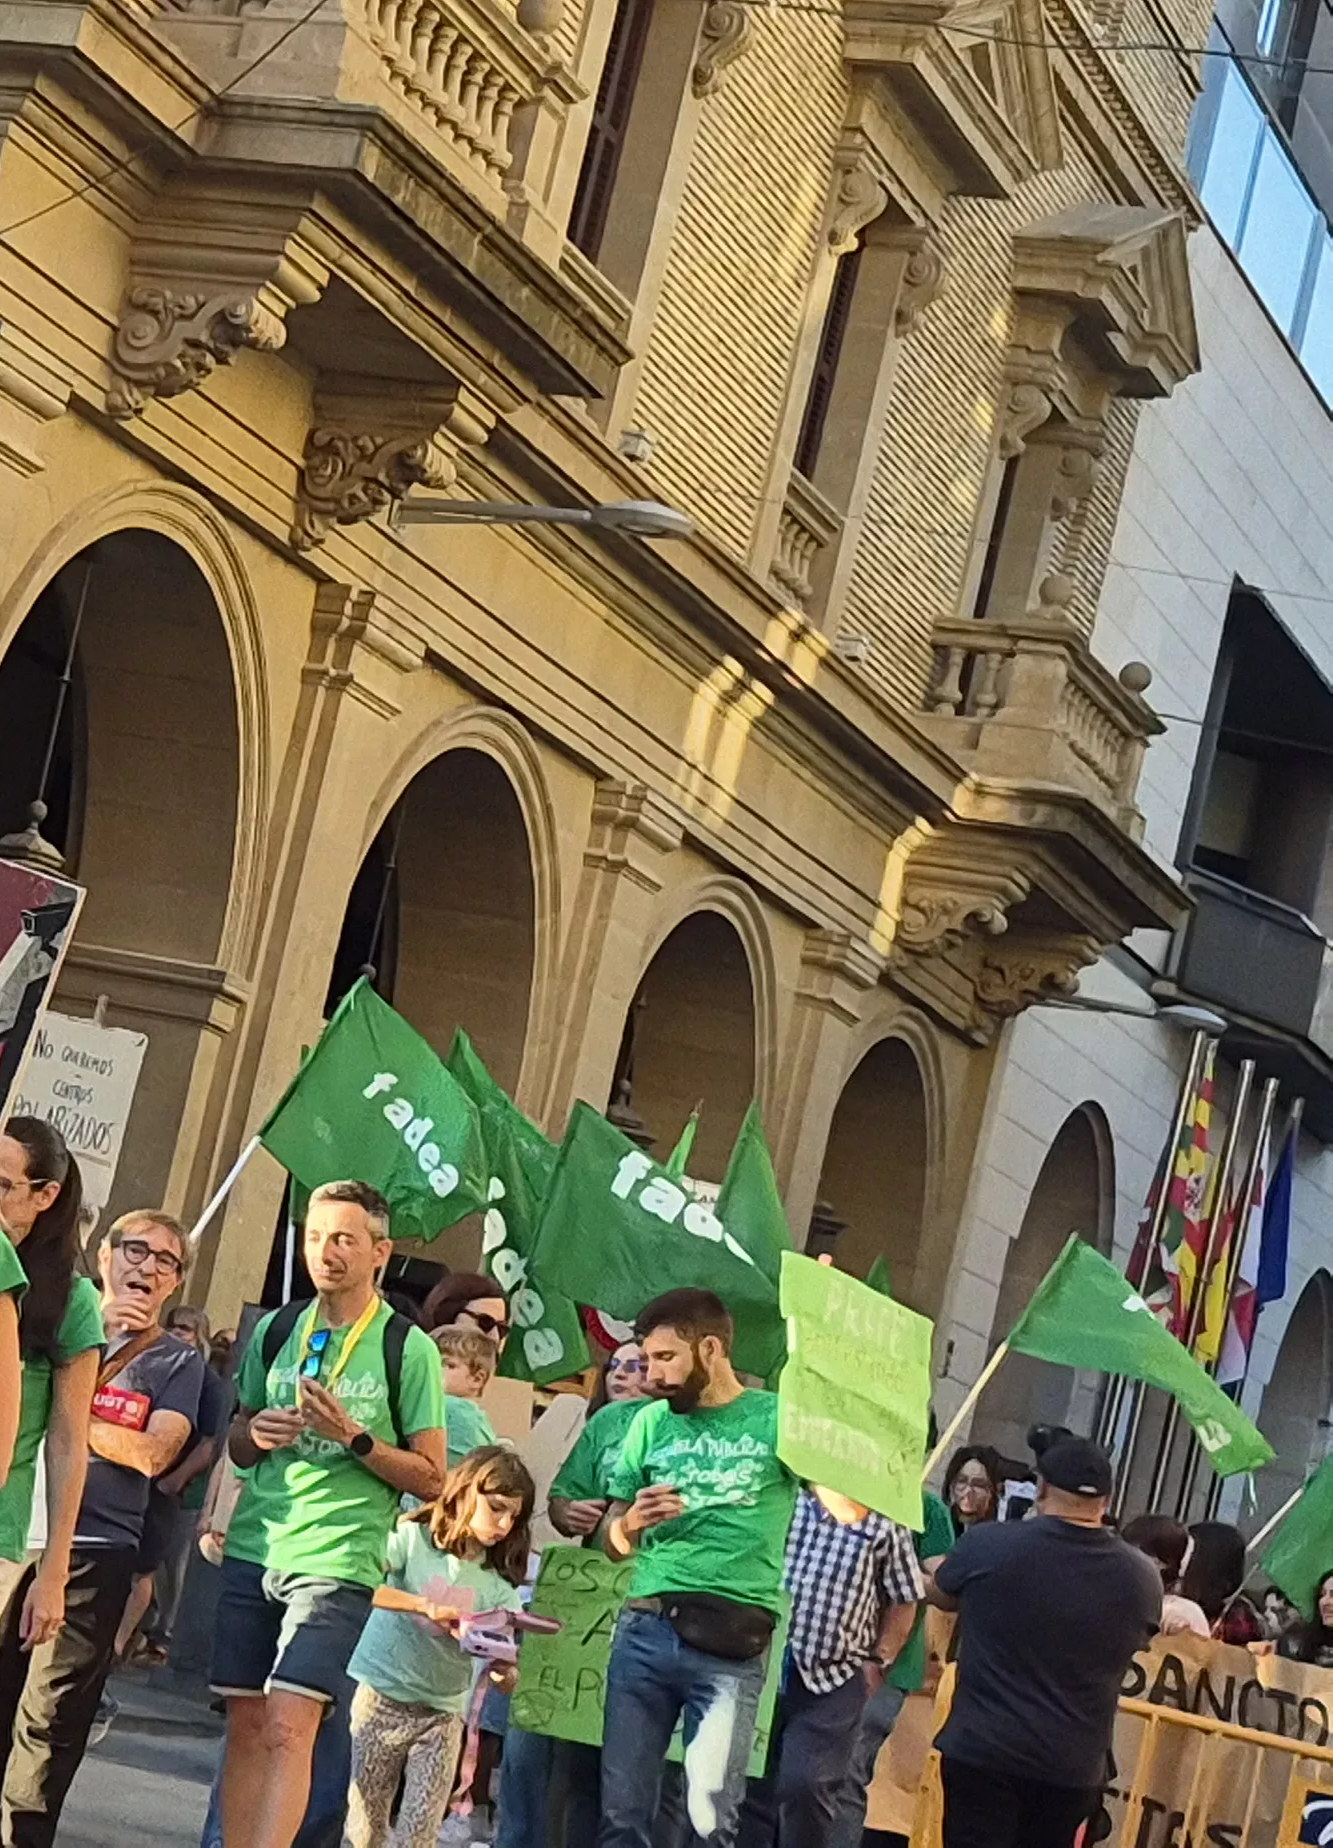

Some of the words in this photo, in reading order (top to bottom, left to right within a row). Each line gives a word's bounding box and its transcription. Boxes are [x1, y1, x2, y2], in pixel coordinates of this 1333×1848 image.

[52, 1078, 94, 1105] CENTROS
[362, 1072, 459, 1198] fadea
[535, 1548, 599, 1593] LOS
[540, 1665, 565, 1691] EL
